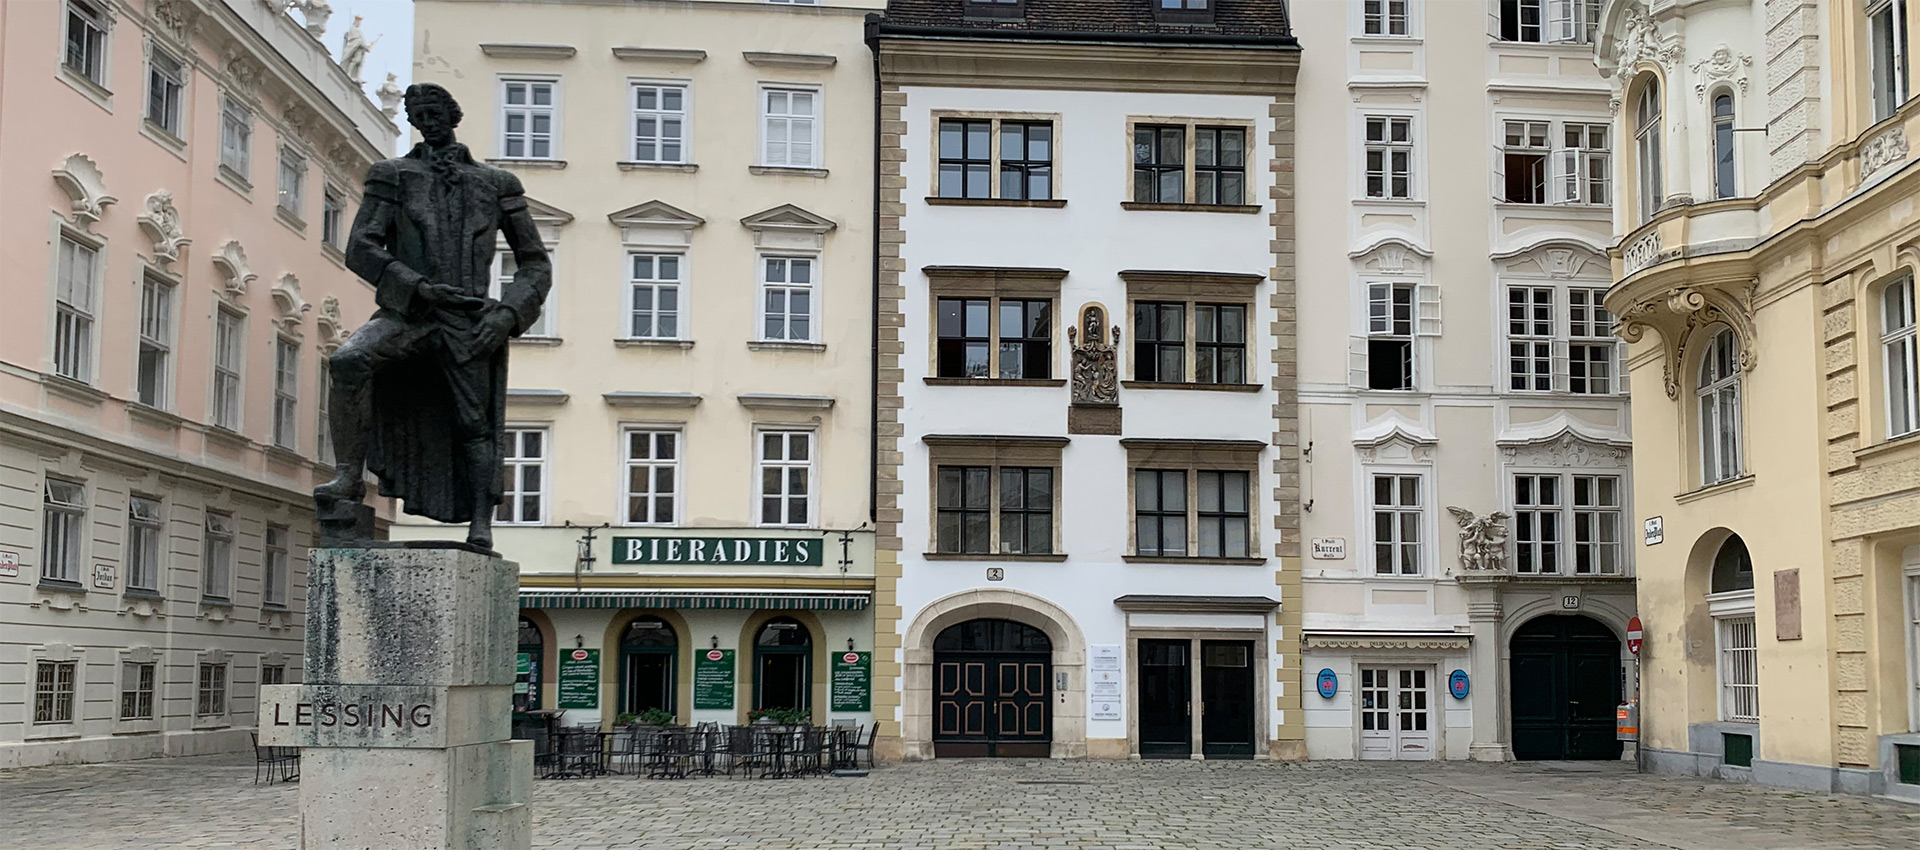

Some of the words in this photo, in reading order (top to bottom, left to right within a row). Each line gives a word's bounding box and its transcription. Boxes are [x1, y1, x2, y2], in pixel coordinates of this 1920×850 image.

[625, 539, 809, 563] BIERADIES
[992, 569, 999, 578] 2
[1567, 597, 1576, 605] 12
[274, 703, 432, 728] LESSING
